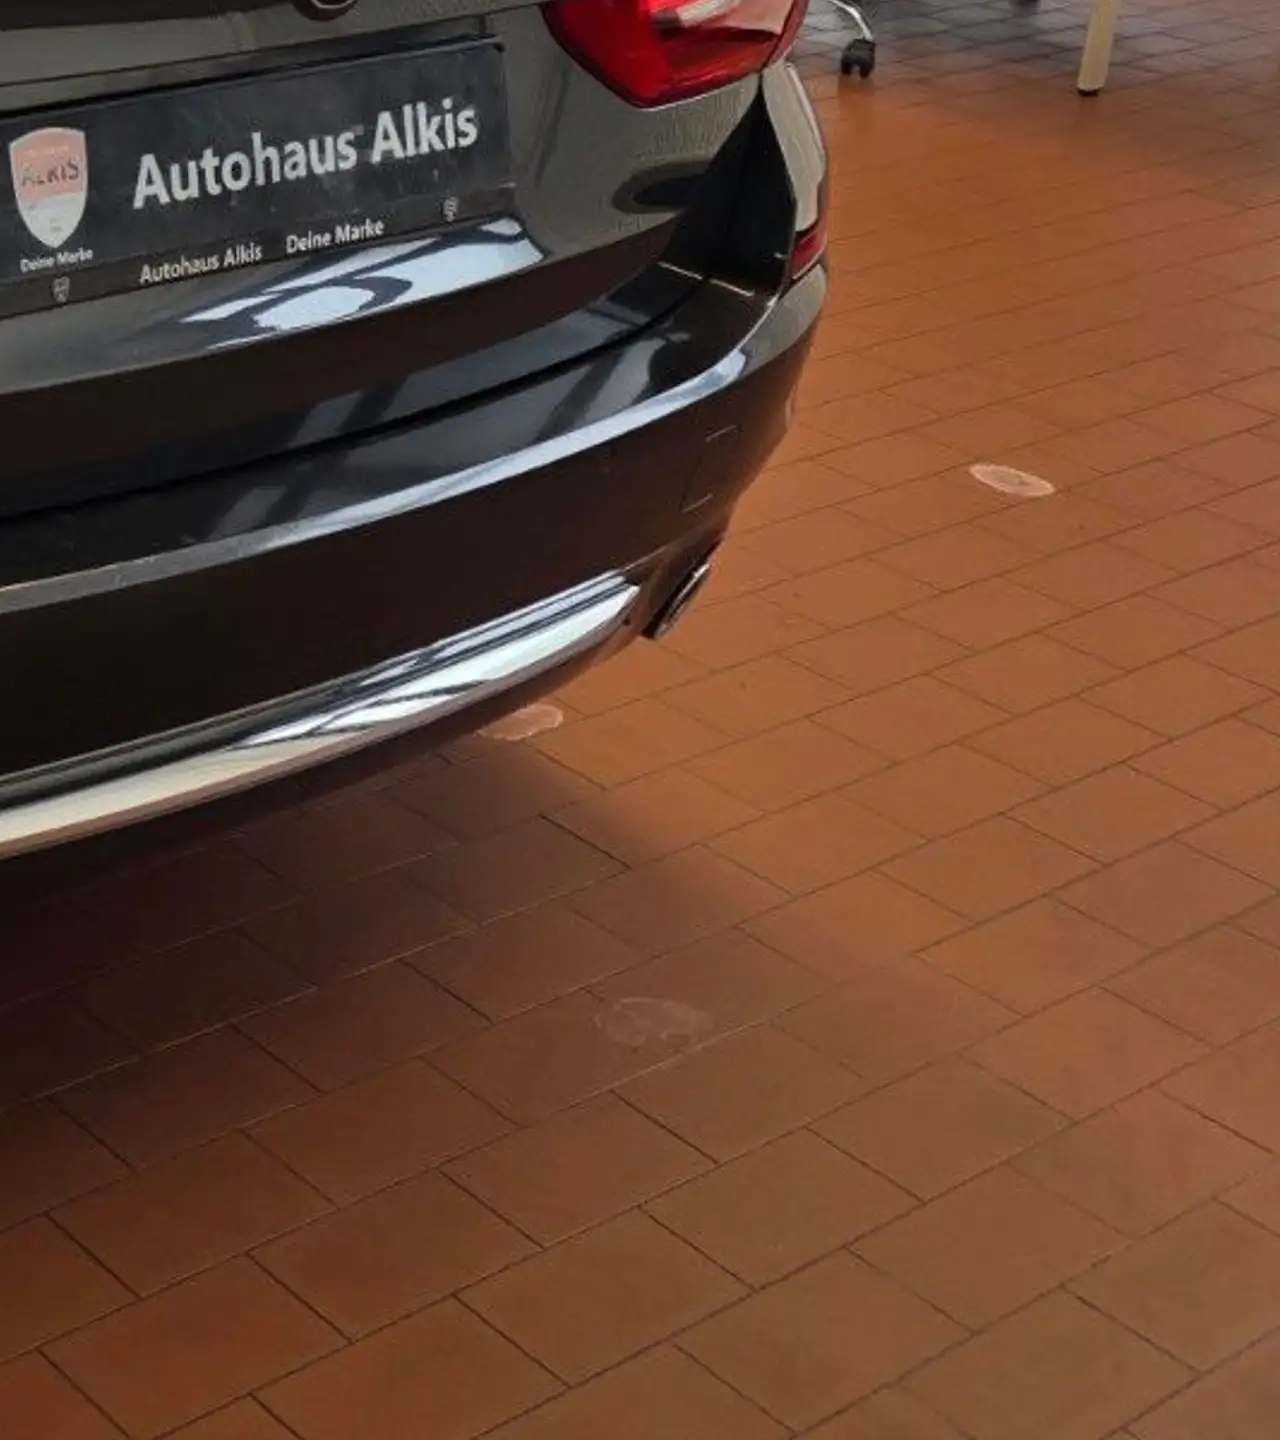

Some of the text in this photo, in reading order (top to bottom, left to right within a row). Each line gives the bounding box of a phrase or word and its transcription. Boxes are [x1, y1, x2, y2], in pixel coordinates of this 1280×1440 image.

[133, 98, 478, 210] Autohaus Alkis
[285, 218, 385, 255] Deine Marke
[140, 242, 263, 285] Autohaus Alkis
